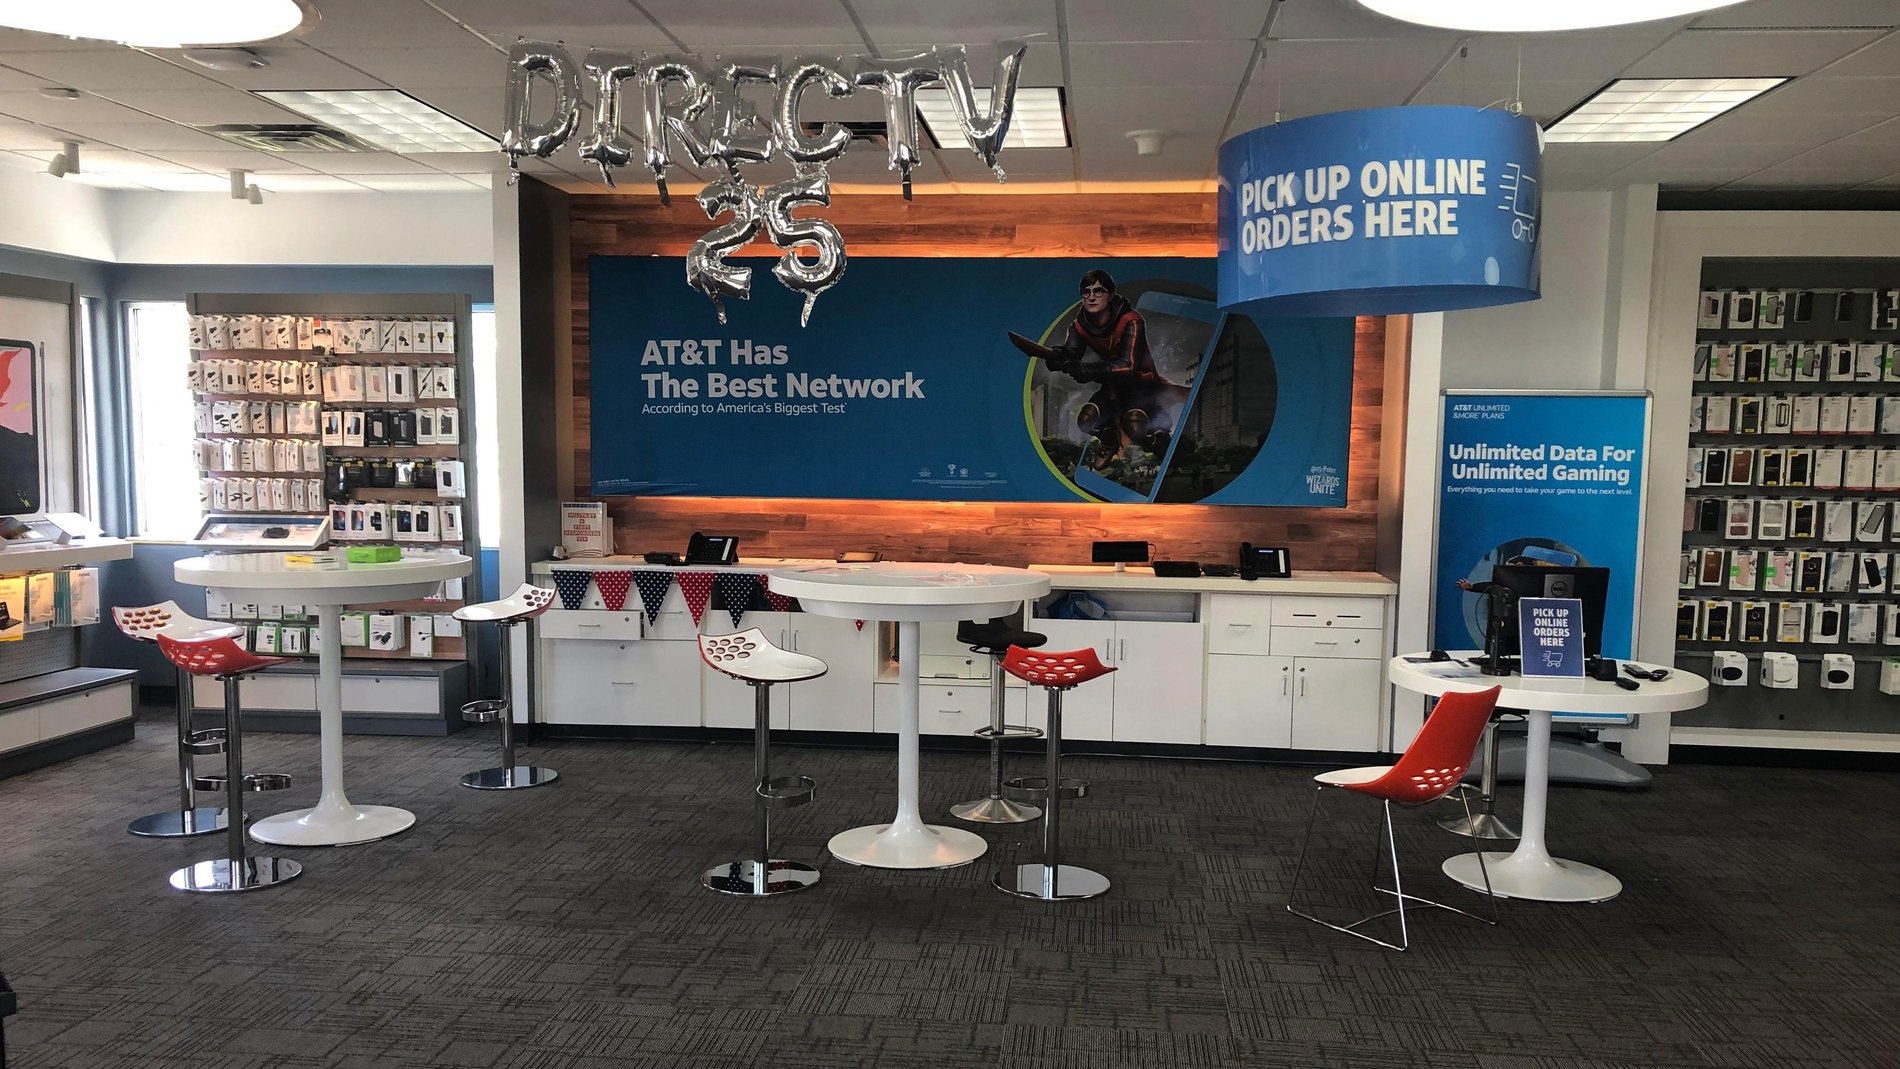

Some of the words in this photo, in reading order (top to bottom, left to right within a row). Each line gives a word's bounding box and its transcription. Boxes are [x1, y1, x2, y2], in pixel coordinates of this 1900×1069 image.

[499, 36, 1028, 172] DIRECTV
[1241, 172, 1297, 217] PICK
[1304, 164, 1351, 205] UP
[1360, 158, 1487, 198] ONLINE
[1241, 204, 1354, 255] ORDERS
[1364, 199, 1459, 238] HERE
[686, 167, 847, 302] 25
[640, 339, 722, 366] AT&T
[730, 339, 789, 366] Has
[641, 371, 700, 399] The
[707, 372, 778, 399] Best
[786, 371, 926, 399] Network
[641, 402, 699, 416] According
[701, 403, 714, 413] to
[716, 402, 772, 414] America's
[774, 402, 819, 416] Biggest
[1473, 404, 1511, 412] UNLIMITED
[1481, 412, 1505, 420] PLANS
[1449, 443, 1545, 461] Unlimited
[1549, 445, 1598, 462] Data
[1602, 446, 1635, 462] For
[1306, 475, 1340, 486] WIZARDS
[1452, 463, 1548, 480] Unlimited
[1552, 464, 1630, 486] Gaming
[1310, 484, 1335, 494] UNITE
[1447, 485, 1483, 494] Everything
[1524, 486, 1539, 494] take
[1586, 487, 1598, 495] the
[1533, 608, 1554, 617] PICK
[1556, 608, 1569, 617] UP
[1534, 618, 1569, 627] ONLINE
[1533, 627, 1570, 637] ORDERS
[1540, 637, 1565, 647] HERE
